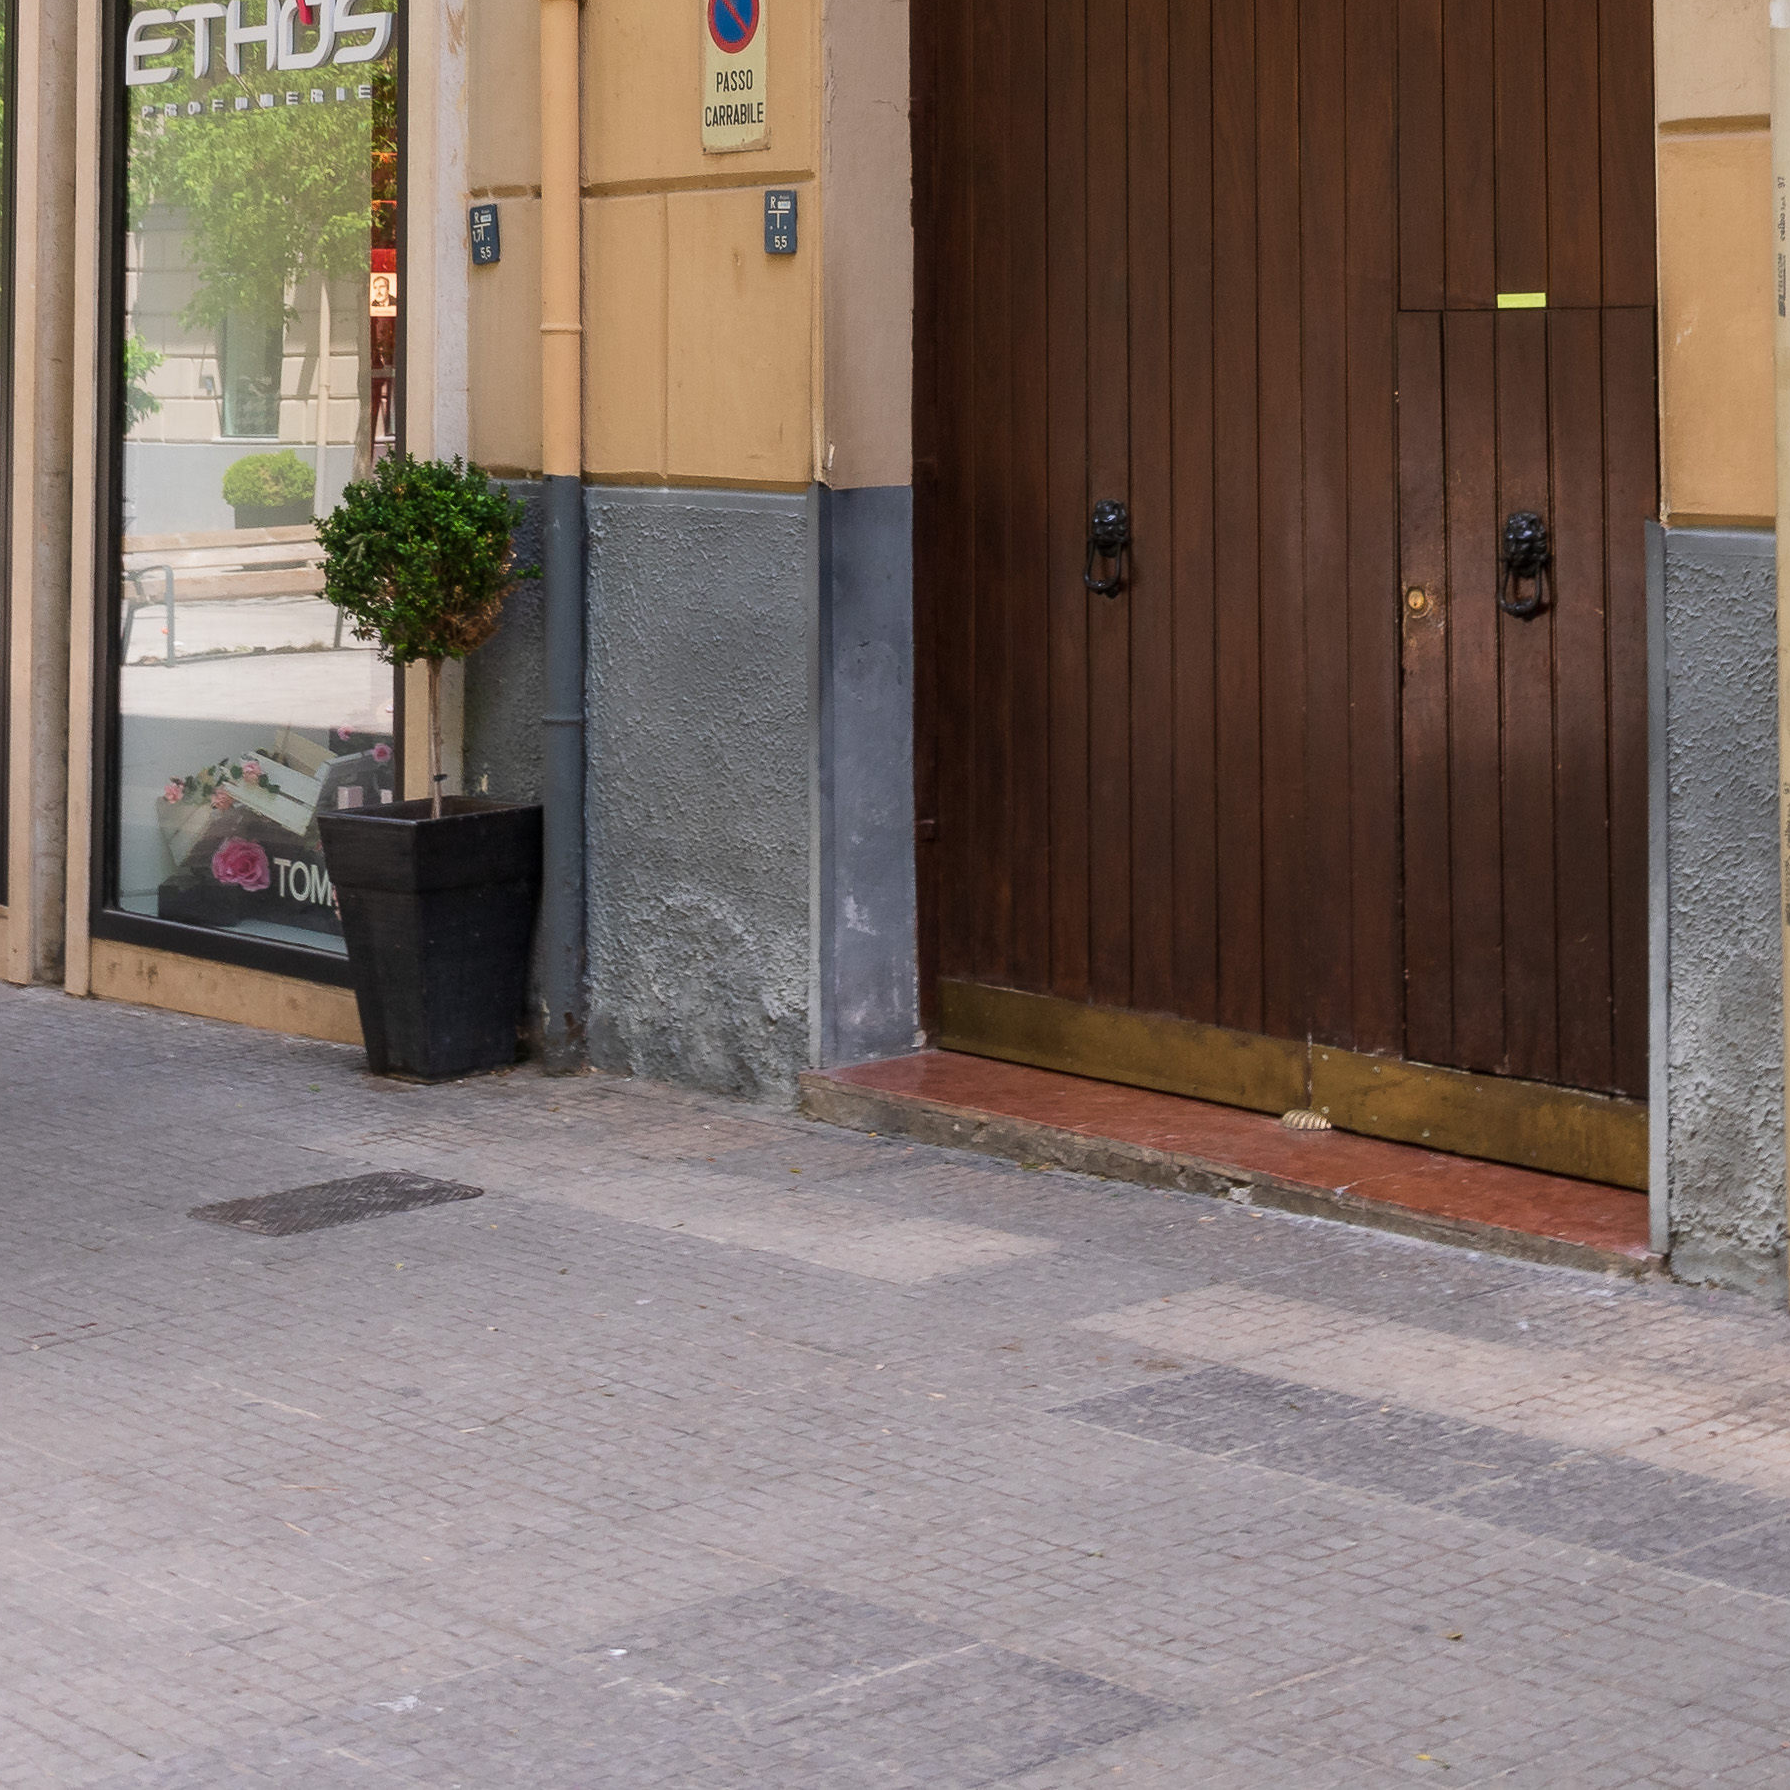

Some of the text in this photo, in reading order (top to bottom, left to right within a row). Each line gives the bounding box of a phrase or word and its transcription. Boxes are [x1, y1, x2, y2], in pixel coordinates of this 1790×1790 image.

[716, 69, 753, 93] PASSO
[141, 84, 372, 118] PROFUMERIE
[704, 102, 764, 128] CARRABILE
[770, 196, 776, 209] R
[774, 235, 788, 250] 5,5
[273, 857, 333, 907] TOM
